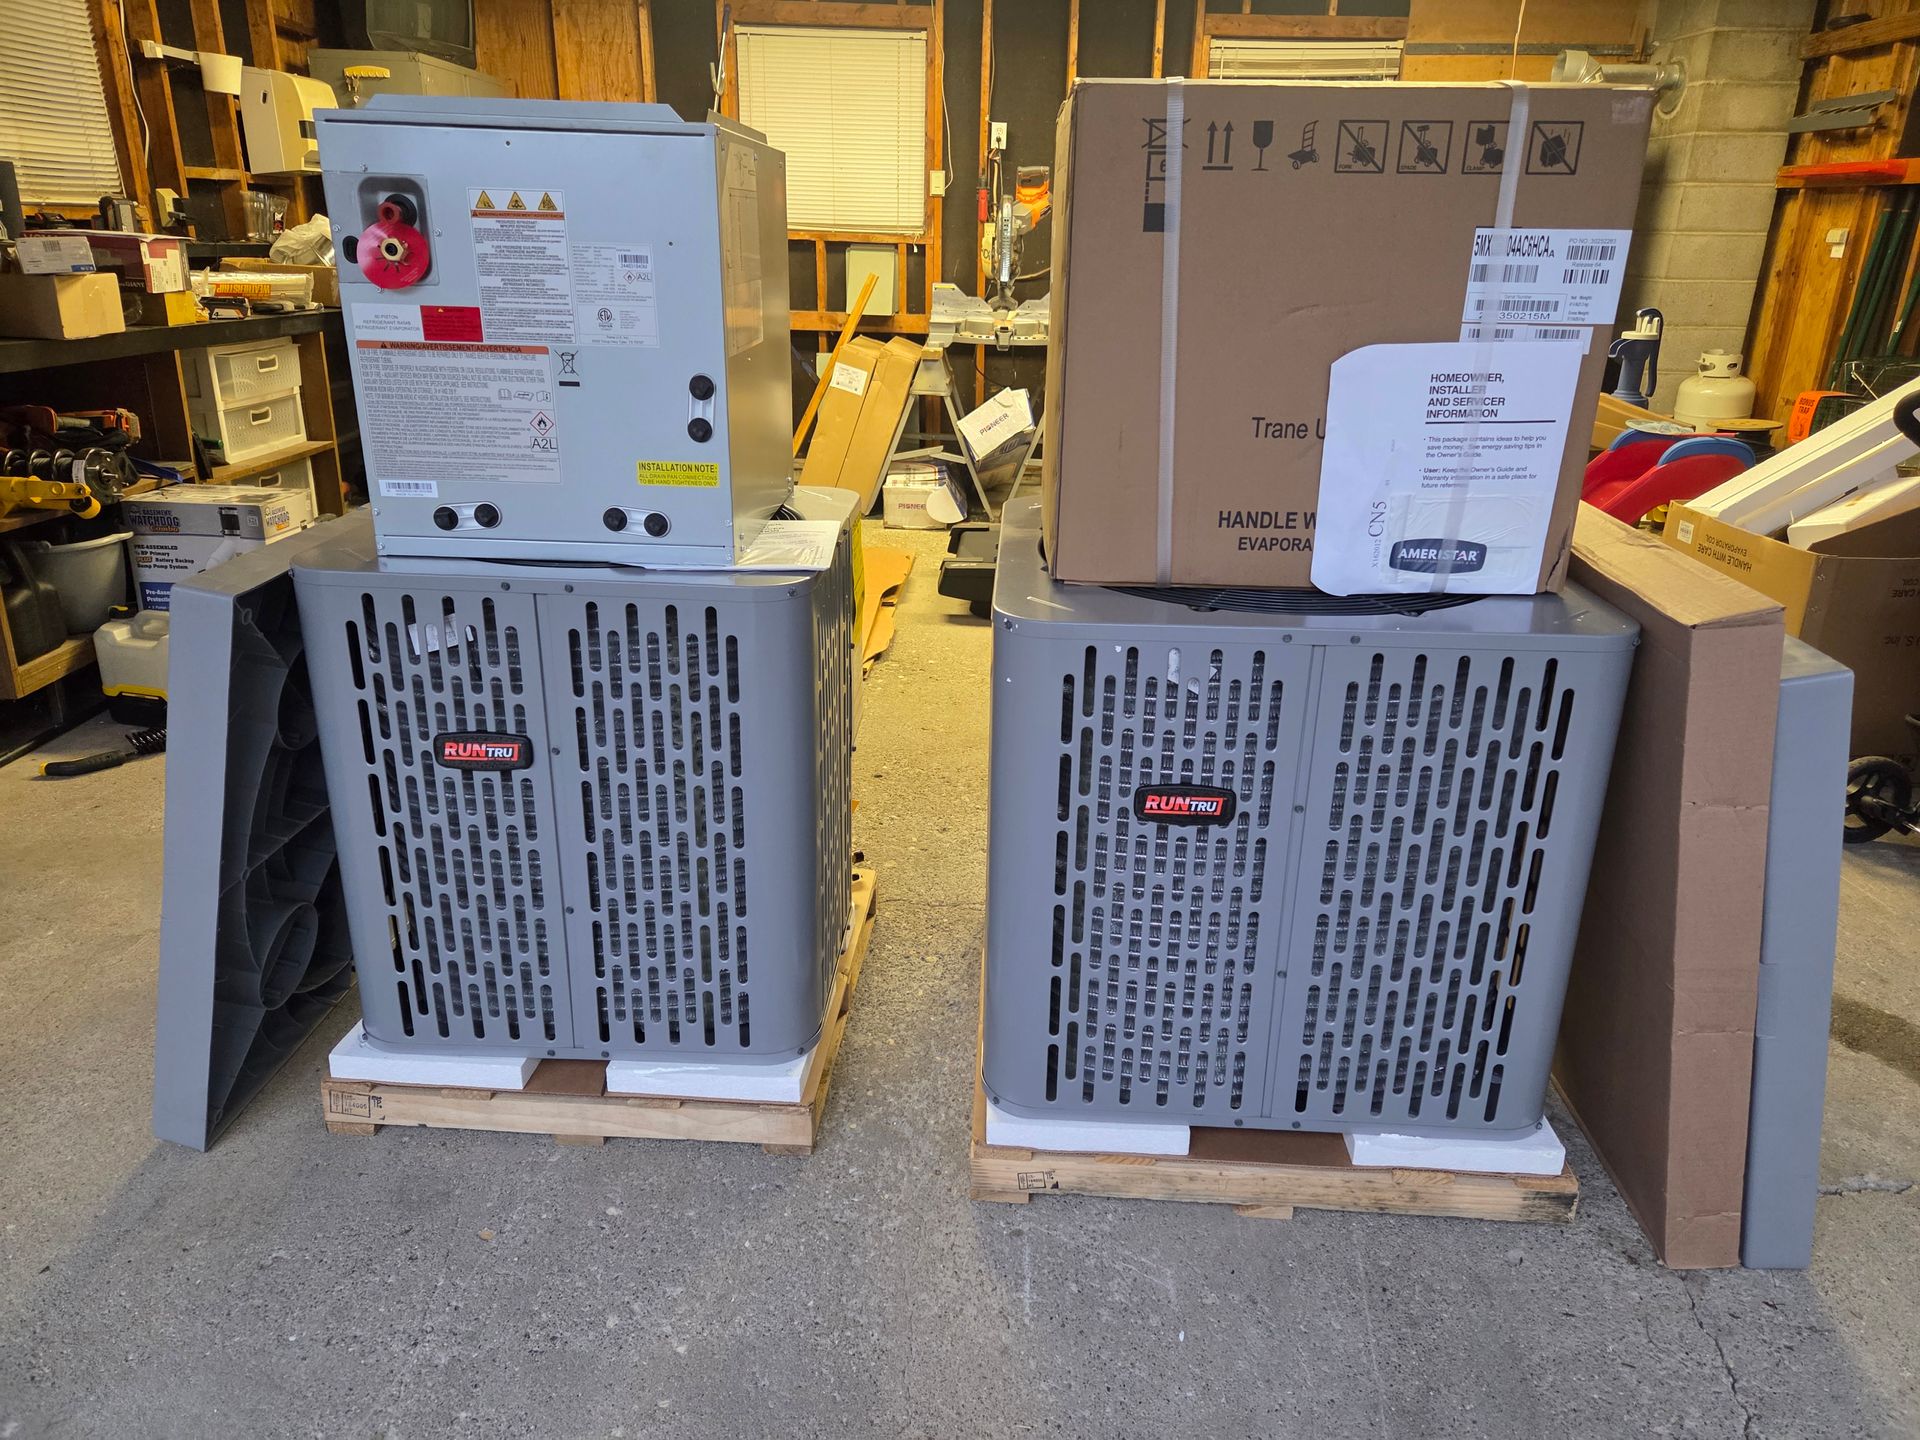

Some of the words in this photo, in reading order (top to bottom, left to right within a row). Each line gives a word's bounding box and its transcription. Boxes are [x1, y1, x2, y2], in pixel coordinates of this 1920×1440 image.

[1430, 373, 1505, 384] HOMEOWNER,
[1429, 385, 1487, 395] INSTALLER
[1428, 398, 1450, 406] AND
[1452, 397, 1505, 406] SERVICER
[1426, 409, 1498, 418] INFORMATION
[980, 413, 1009, 436] PIONEER
[1252, 416, 1308, 439] Trane
[532, 438, 557, 450] A2L
[638, 462, 692, 472] INSTALLATION
[695, 464, 718, 473] NOTE:
[129, 514, 180, 526] WATCHDOG
[1218, 511, 1298, 530] HANDLE
[1368, 501, 1387, 537] CN5
[1238, 537, 1313, 552] EVAPORA
[1697, 543, 1712, 557] CARE
[1716, 540, 1747, 557] EVAPORATOR
[1398, 548, 1477, 561] AMERISTAR
[1712, 550, 1726, 563] WITH
[1727, 556, 1752, 572] HANDLE
